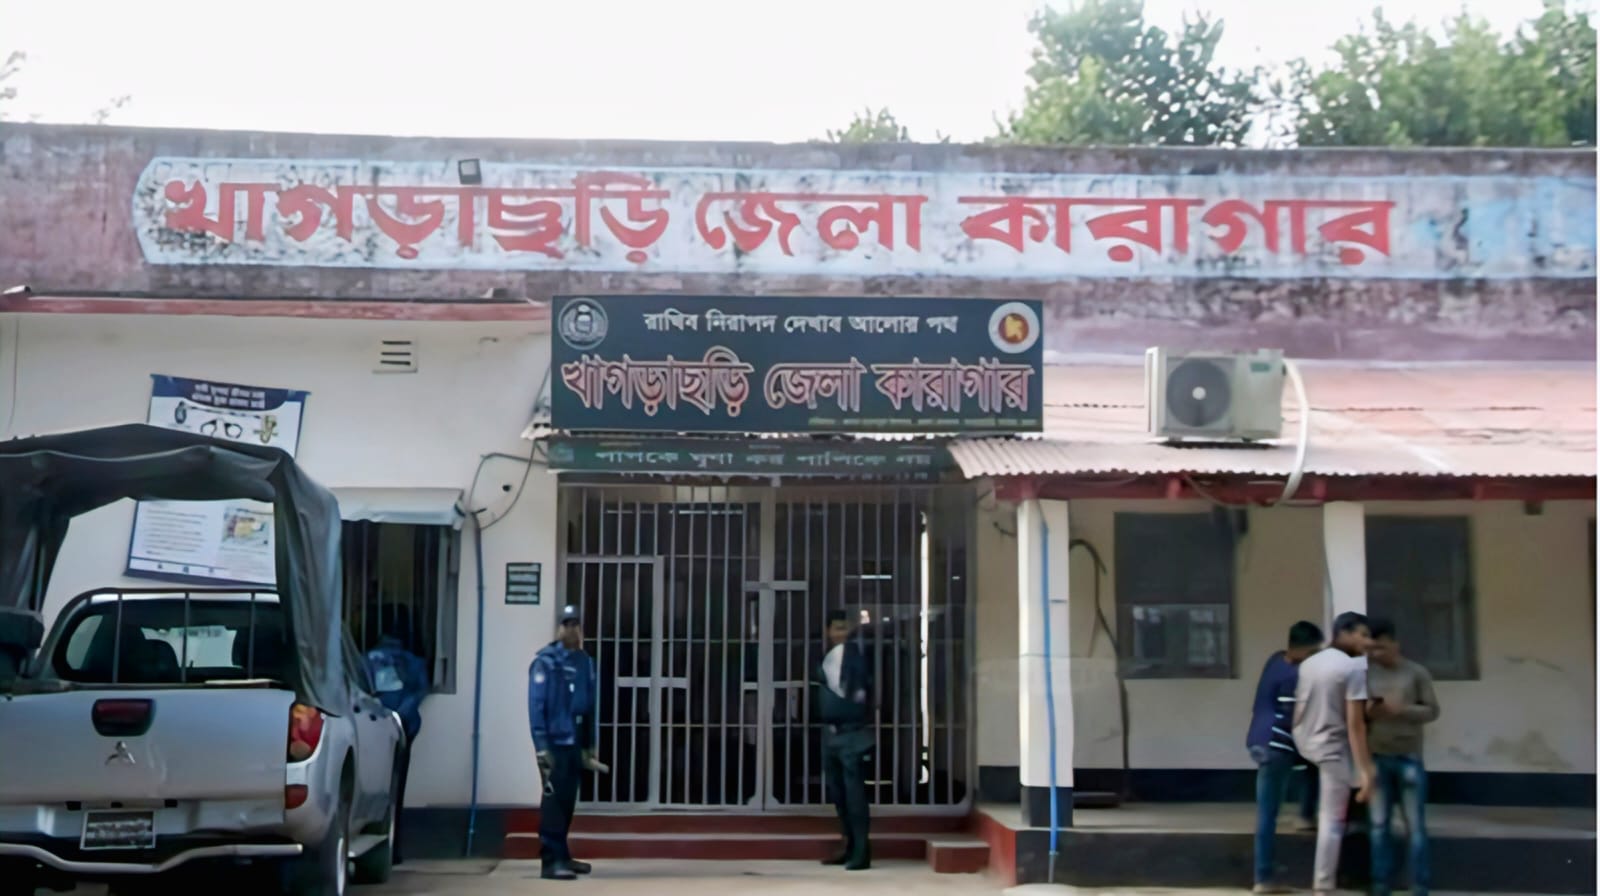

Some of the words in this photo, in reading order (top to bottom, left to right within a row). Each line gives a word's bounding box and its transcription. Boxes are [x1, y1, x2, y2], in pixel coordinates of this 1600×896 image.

[164, 172, 671, 262] খাগড়াছড়ি
[694, 192, 929, 257] জেলা
[958, 194, 1395, 266] কারাগার
[561, 346, 754, 417] খাগড়াছড়ি
[764, 357, 867, 411] জেলা
[871, 357, 1035, 412] কারাগার
